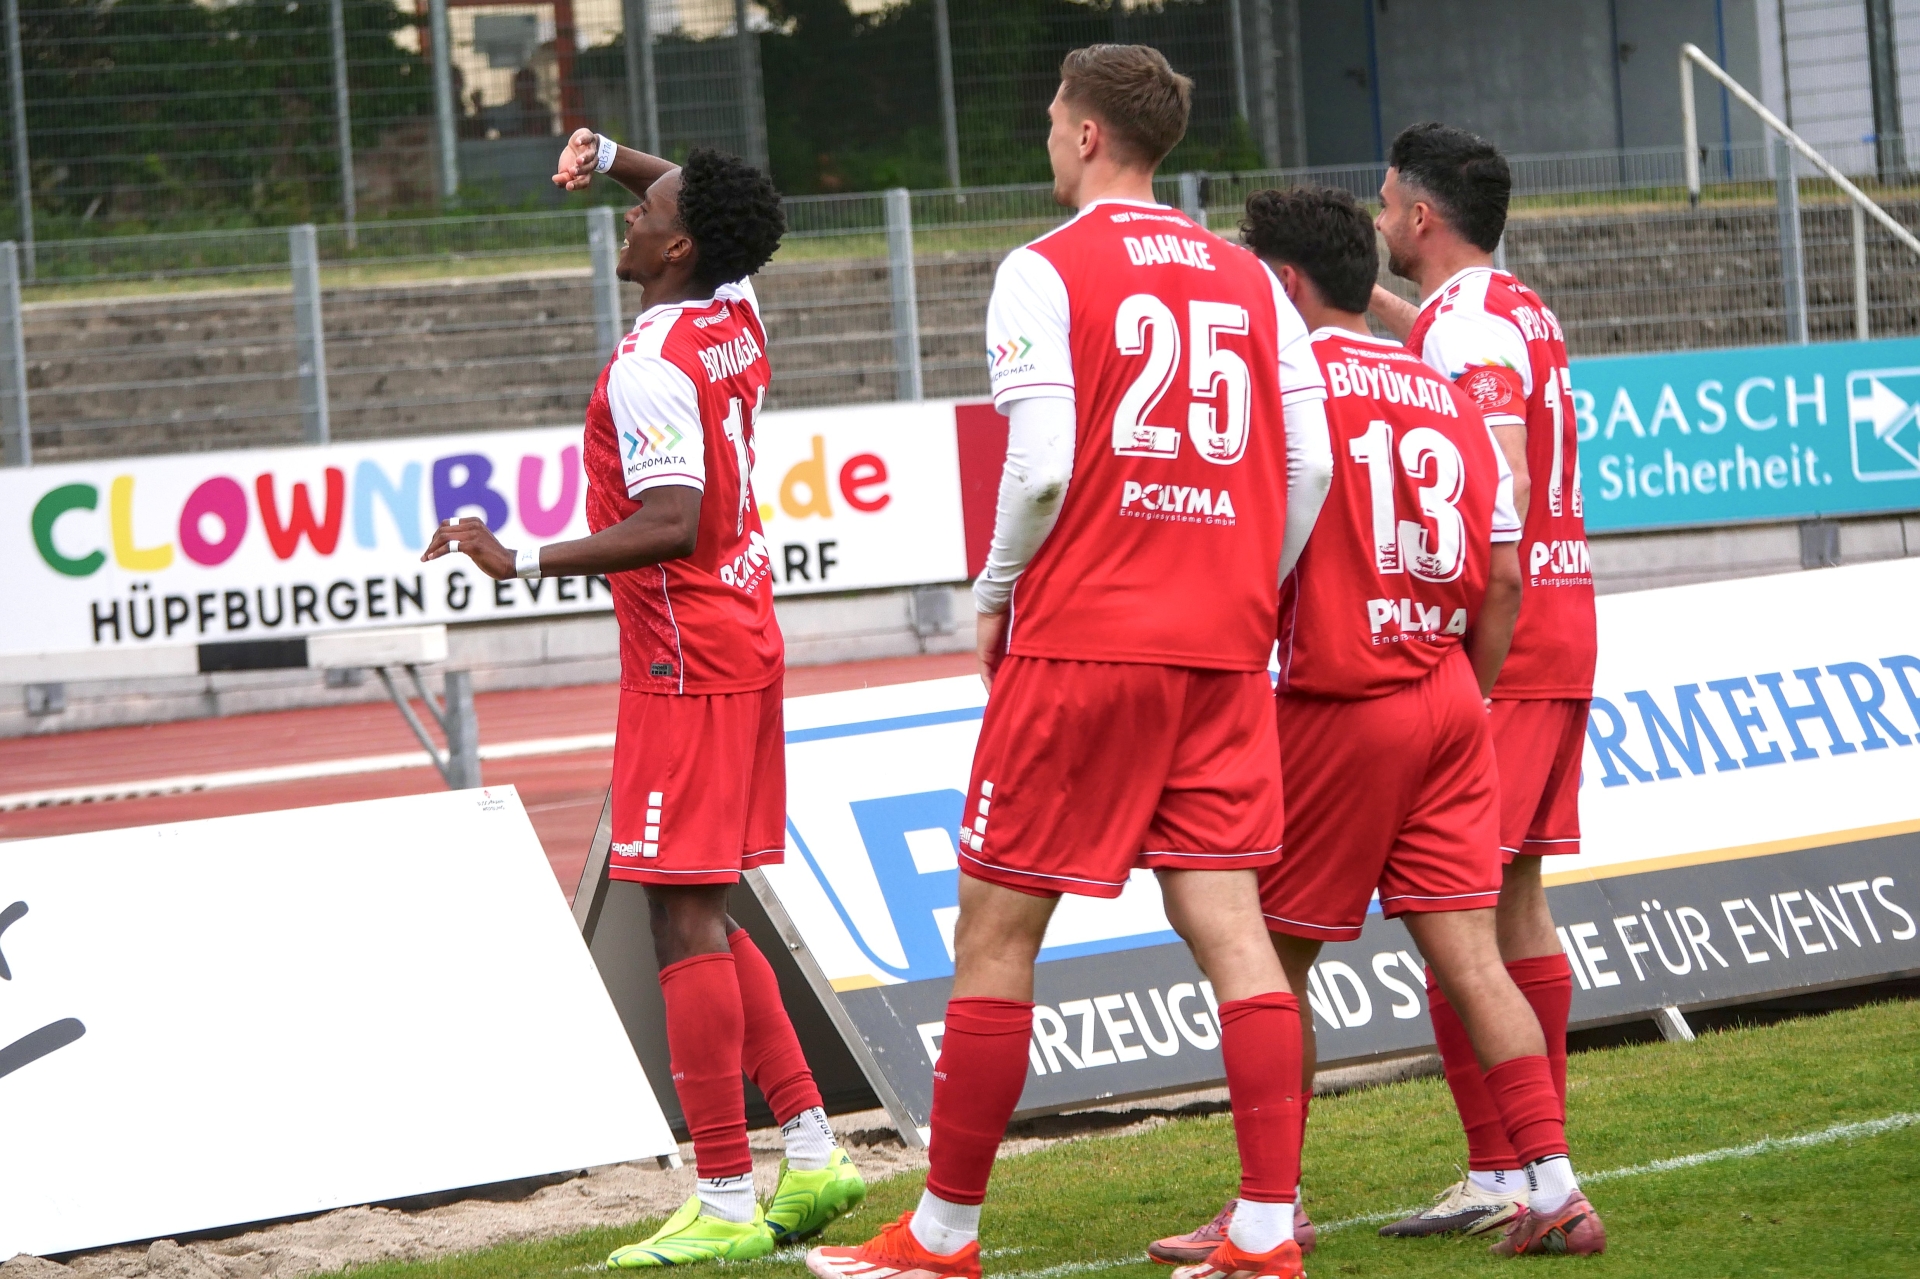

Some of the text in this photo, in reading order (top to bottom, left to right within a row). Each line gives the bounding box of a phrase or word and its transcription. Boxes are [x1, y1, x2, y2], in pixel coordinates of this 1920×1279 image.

[1123, 234, 1216, 271] DAHLKE
[1112, 293, 1252, 465] 25
[1326, 357, 1459, 418] BÖYÜKATA
[627, 456, 687, 476] MICROMATA
[1599, 443, 1832, 501] Sicherheit.
[1119, 508, 1237, 526] Energiesysteme GmbH
[1121, 480, 1236, 518] POLYMA
[1348, 420, 1466, 584] 13
[1529, 540, 1592, 576] POLYM
[91, 571, 427, 643] HÜPFBURGEN
[446, 570, 472, 611] &
[1613, 899, 1729, 982] FÜR
[1720, 876, 1916, 964] EVENTS
[1307, 960, 1373, 1032] ND
[1526, 1164, 1539, 1192] ESIGN
